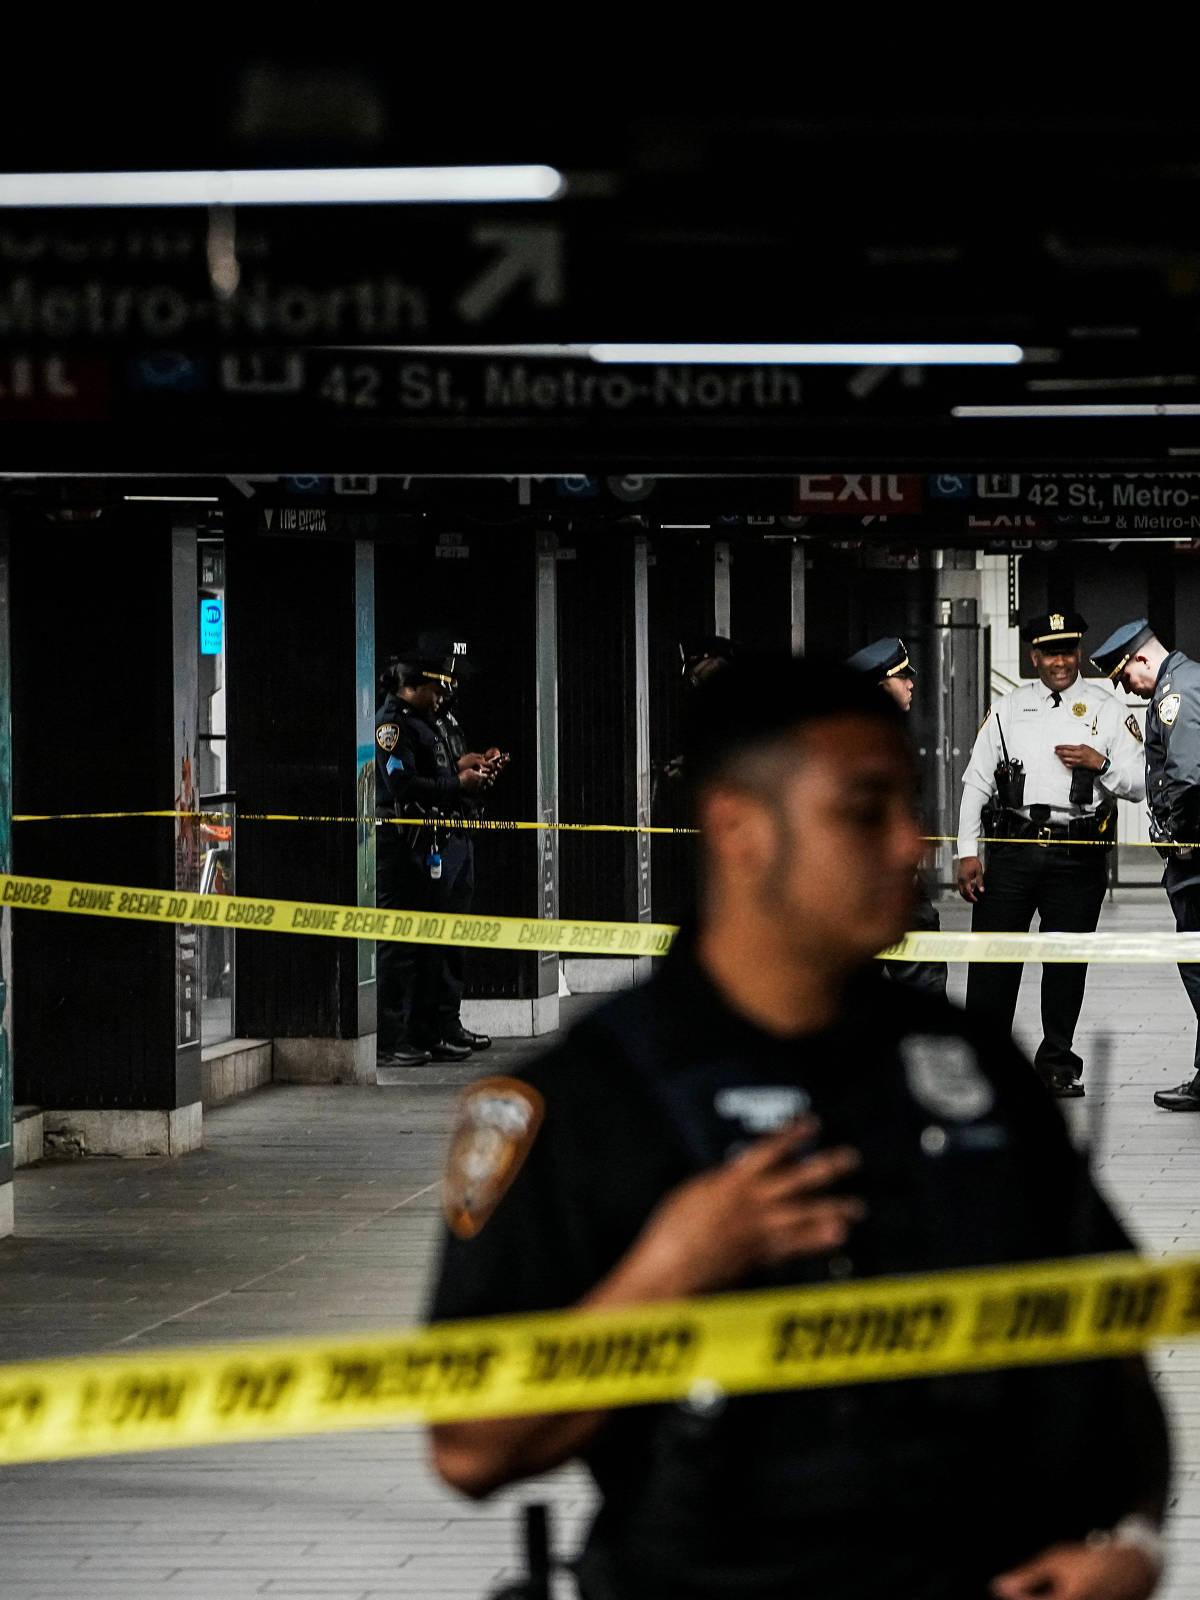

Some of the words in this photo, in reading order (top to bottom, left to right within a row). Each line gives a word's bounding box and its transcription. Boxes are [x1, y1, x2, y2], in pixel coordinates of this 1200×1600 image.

[319, 363, 382, 409] 42
[483, 364, 802, 409] Metro-North
[1028, 483, 1059, 507] 42
[1068, 483, 1104, 510] St,
[1115, 515, 1128, 528] &
